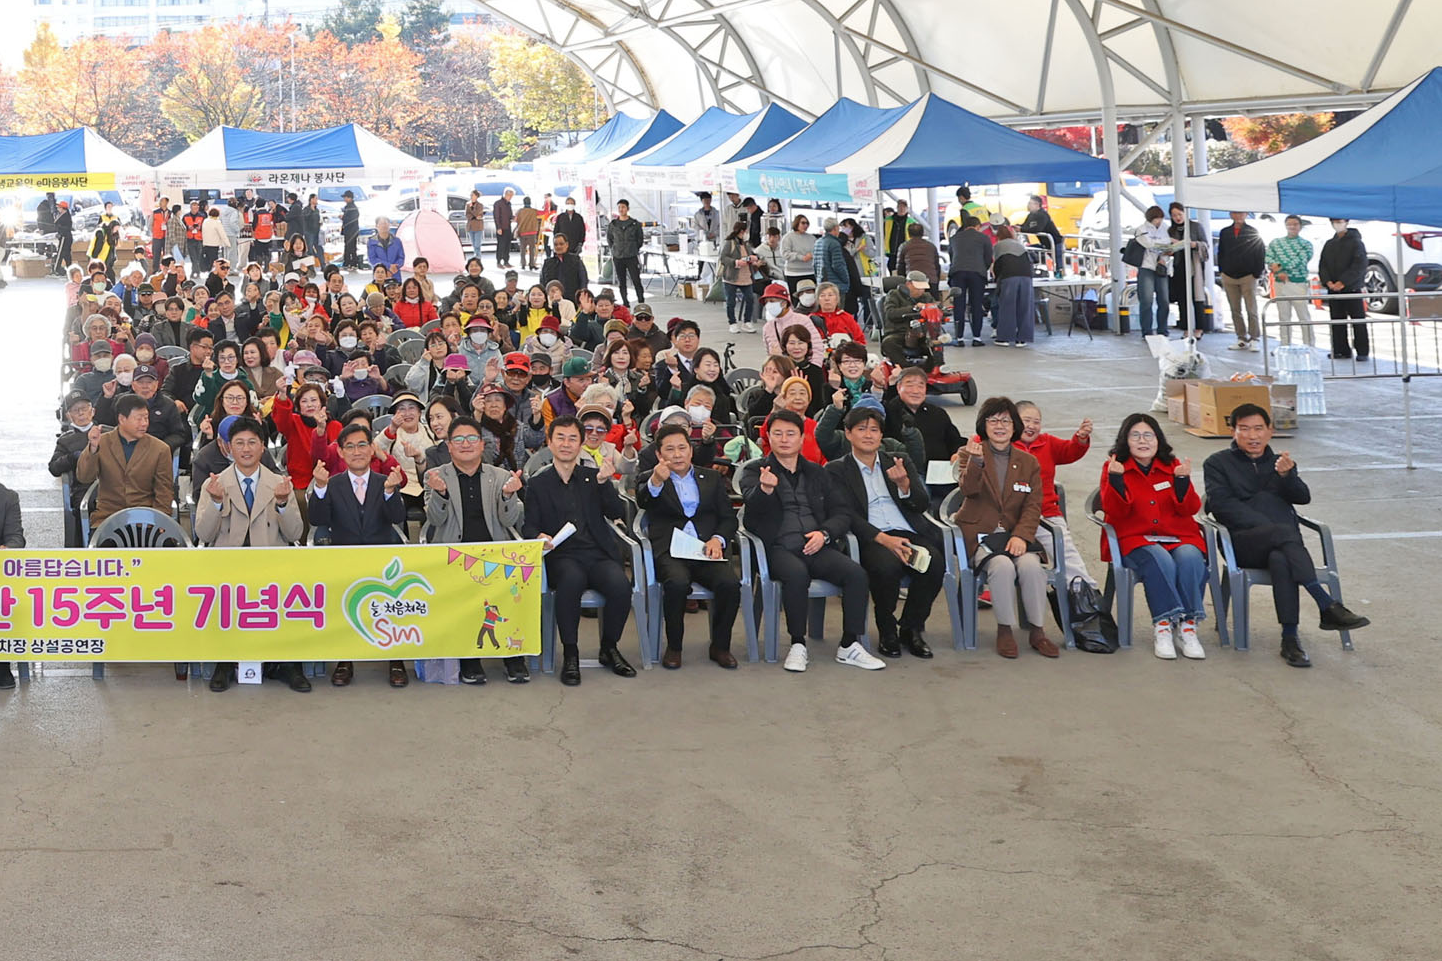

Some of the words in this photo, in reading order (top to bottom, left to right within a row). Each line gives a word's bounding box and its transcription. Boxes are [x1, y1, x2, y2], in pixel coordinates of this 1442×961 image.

[268, 174, 311, 185] 라온제나
[314, 172, 345, 184] 봉사단
[27, 585, 173, 630] 15주년
[188, 583, 326, 630] 기념식
[371, 601, 382, 617] 늘
[384, 600, 427, 616] 처음처럼
[30, 639, 105, 654] 상설공연장
